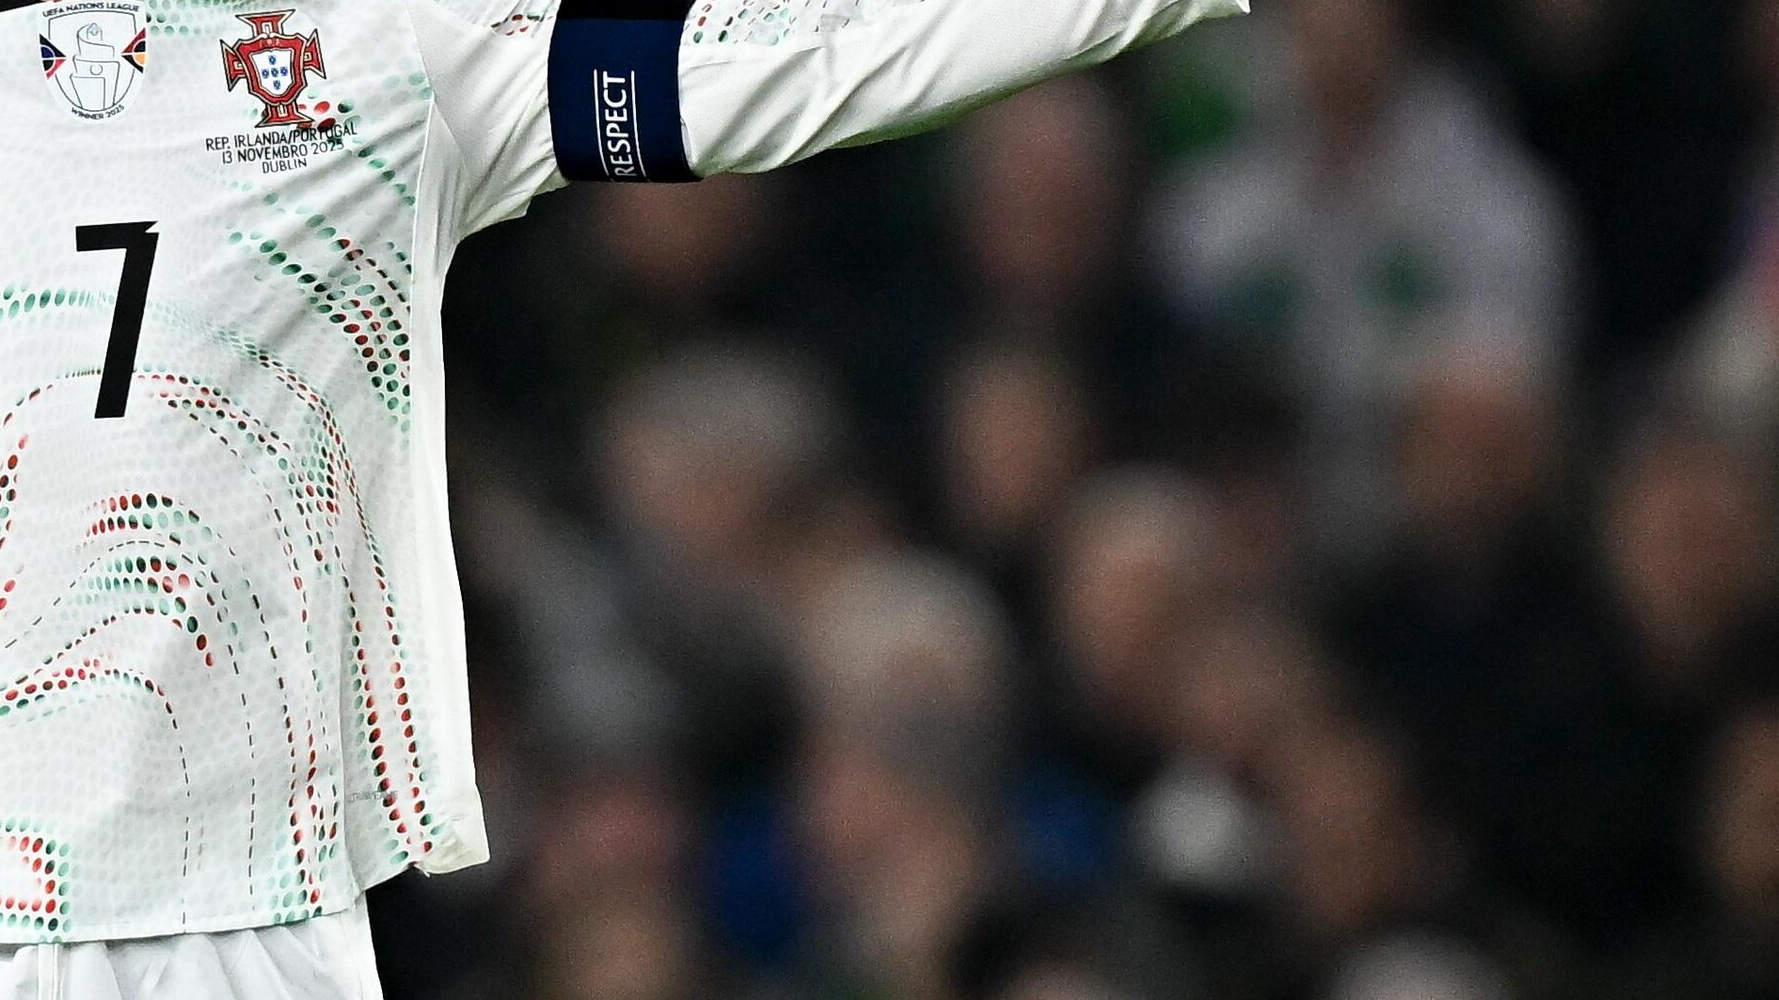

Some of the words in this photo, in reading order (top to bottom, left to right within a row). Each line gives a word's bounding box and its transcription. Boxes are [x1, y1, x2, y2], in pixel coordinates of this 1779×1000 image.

[66, 3, 104, 12] NATIONS
[106, 3, 139, 12] LEAGUE
[205, 136, 230, 151] REP.
[234, 122, 358, 148] IRLANDA/PORTUGAL
[602, 71, 637, 177] RESPECT
[222, 150, 233, 164] 13
[237, 144, 308, 163] NOVEMBRO
[310, 139, 345, 155] 2025
[262, 158, 308, 174] DUBLIN
[75, 220, 160, 418] 7
